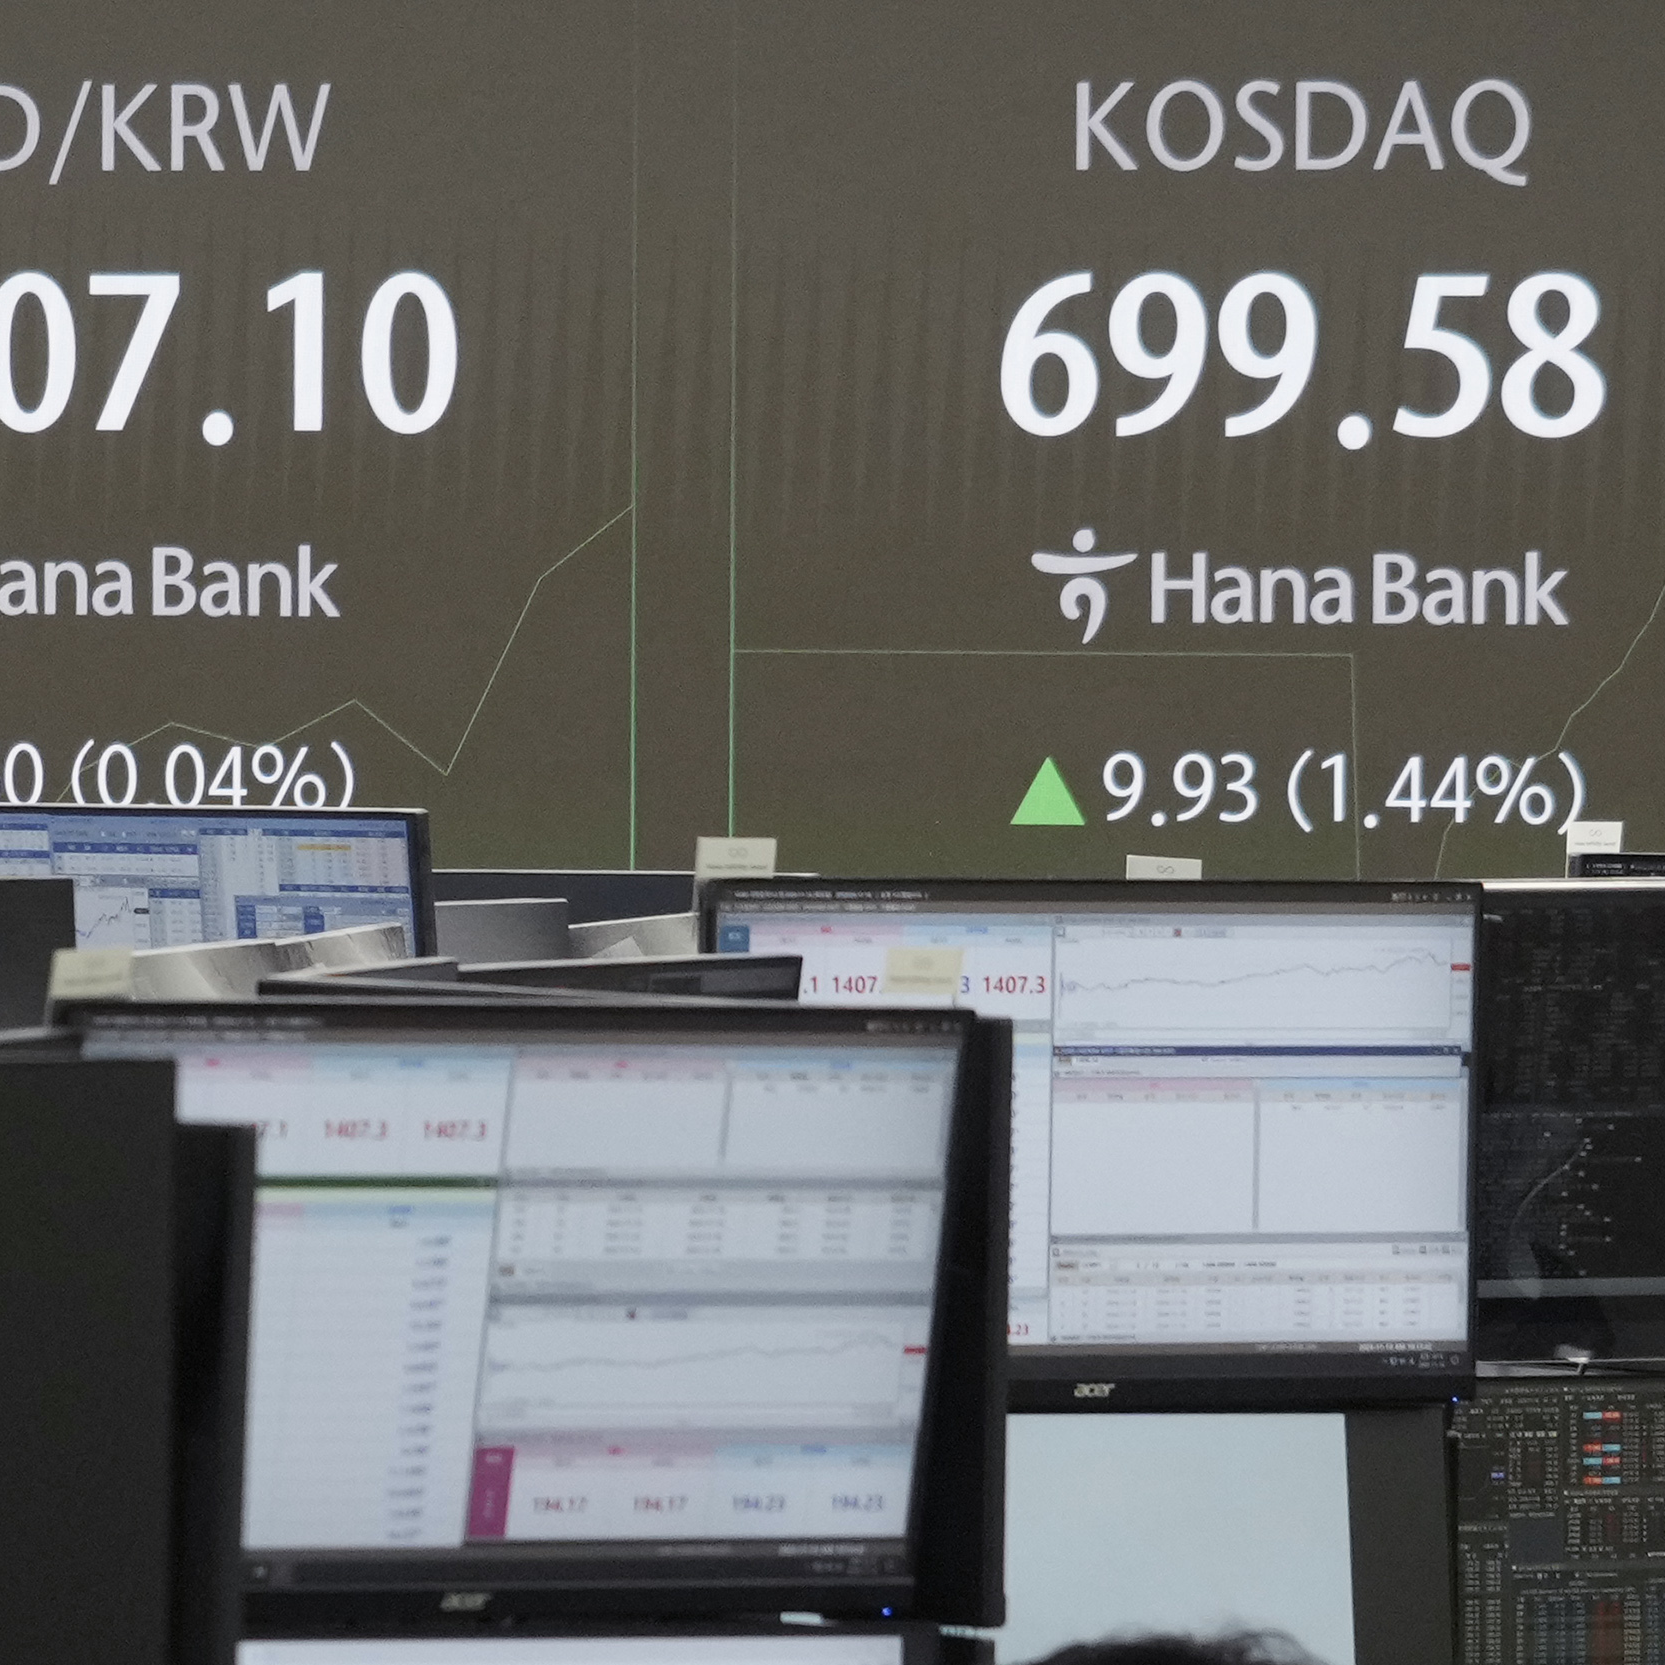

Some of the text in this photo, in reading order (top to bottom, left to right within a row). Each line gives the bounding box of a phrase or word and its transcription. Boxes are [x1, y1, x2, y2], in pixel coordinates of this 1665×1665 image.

[1075, 78, 1532, 187] KOSDAQ
[1000, 272, 1607, 451] 699.58
[151, 544, 341, 618] Bank
[1150, 550, 1569, 626] Hana Bank
[71, 738, 354, 808] (004%)
[1102, 748, 1586, 836] 9.93 (1.44%)
[833, 974, 885, 995] 1407.
[983, 974, 1046, 995] 1407.3
